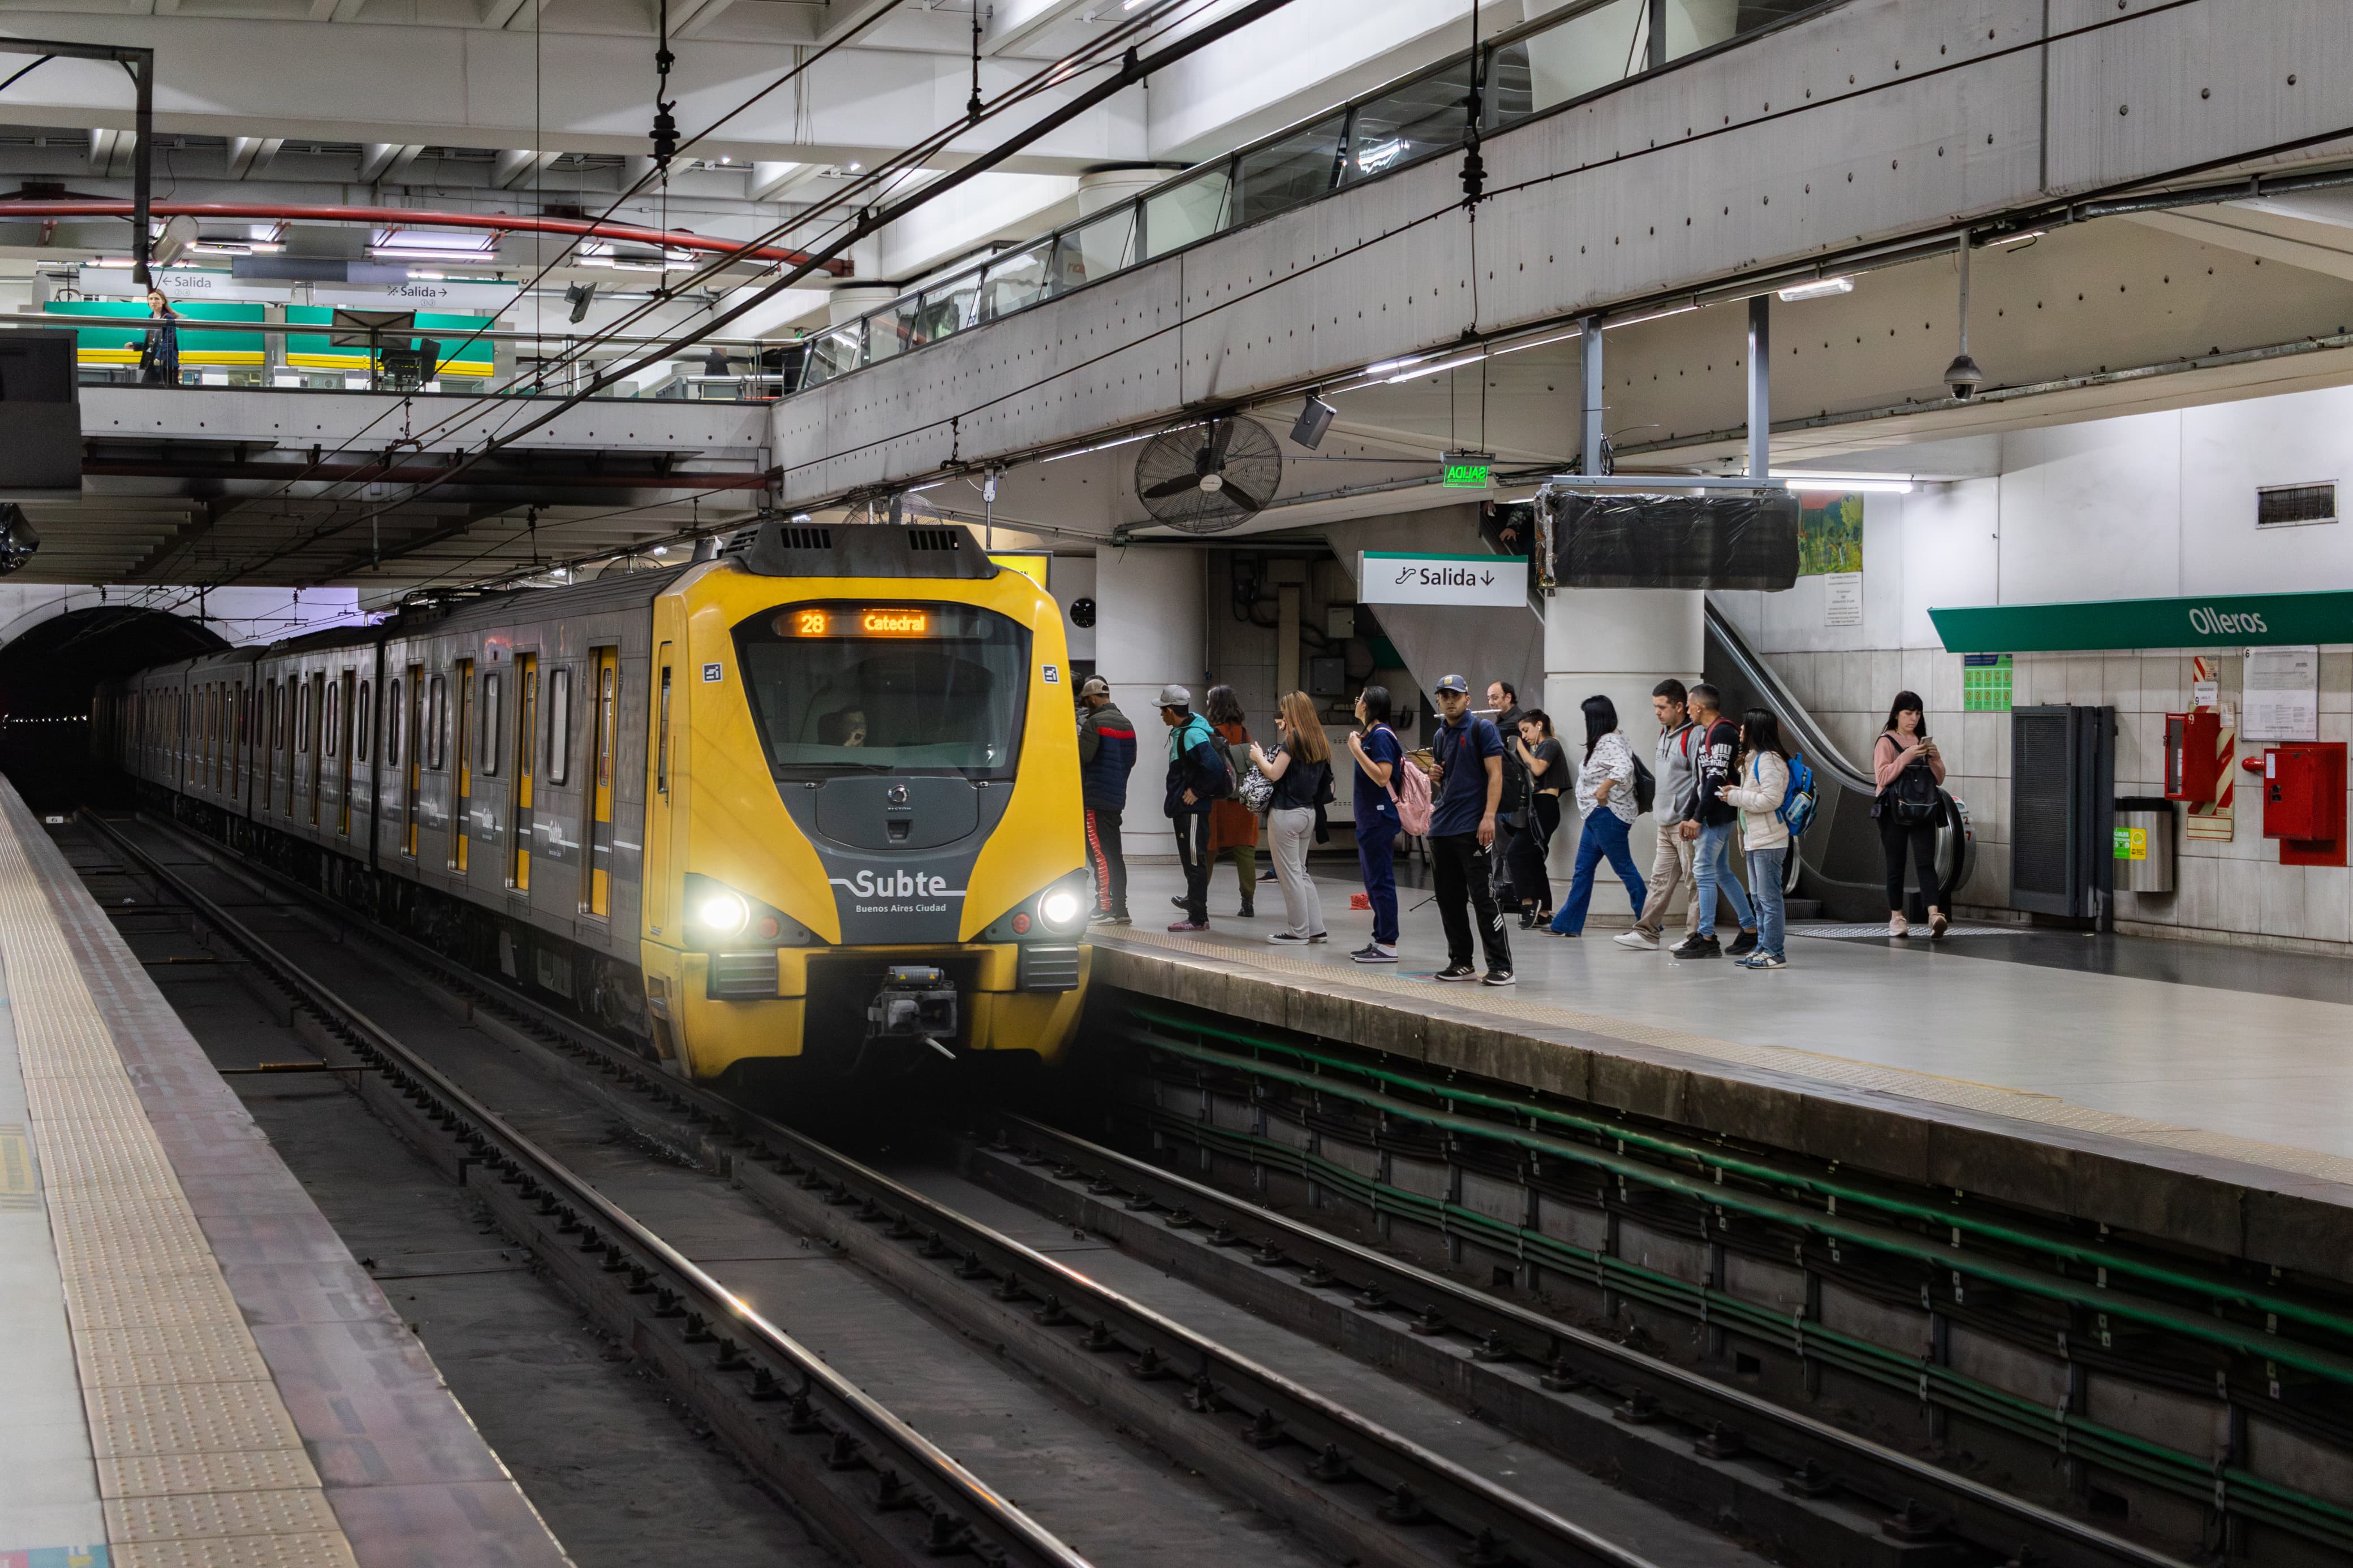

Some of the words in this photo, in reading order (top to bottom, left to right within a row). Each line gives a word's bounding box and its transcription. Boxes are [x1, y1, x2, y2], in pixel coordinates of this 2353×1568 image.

[175, 276, 212, 288] Salida
[400, 286, 436, 297] Salida
[1420, 568, 1476, 586] Salida
[801, 615, 824, 633] 28
[864, 615, 925, 631] Catedral
[2189, 607, 2268, 634] Olleros
[2195, 697, 2199, 705] 9
[856, 870, 946, 898] Subte
[890, 904, 913, 913] Aires
[915, 904, 946, 912] Ciudad
